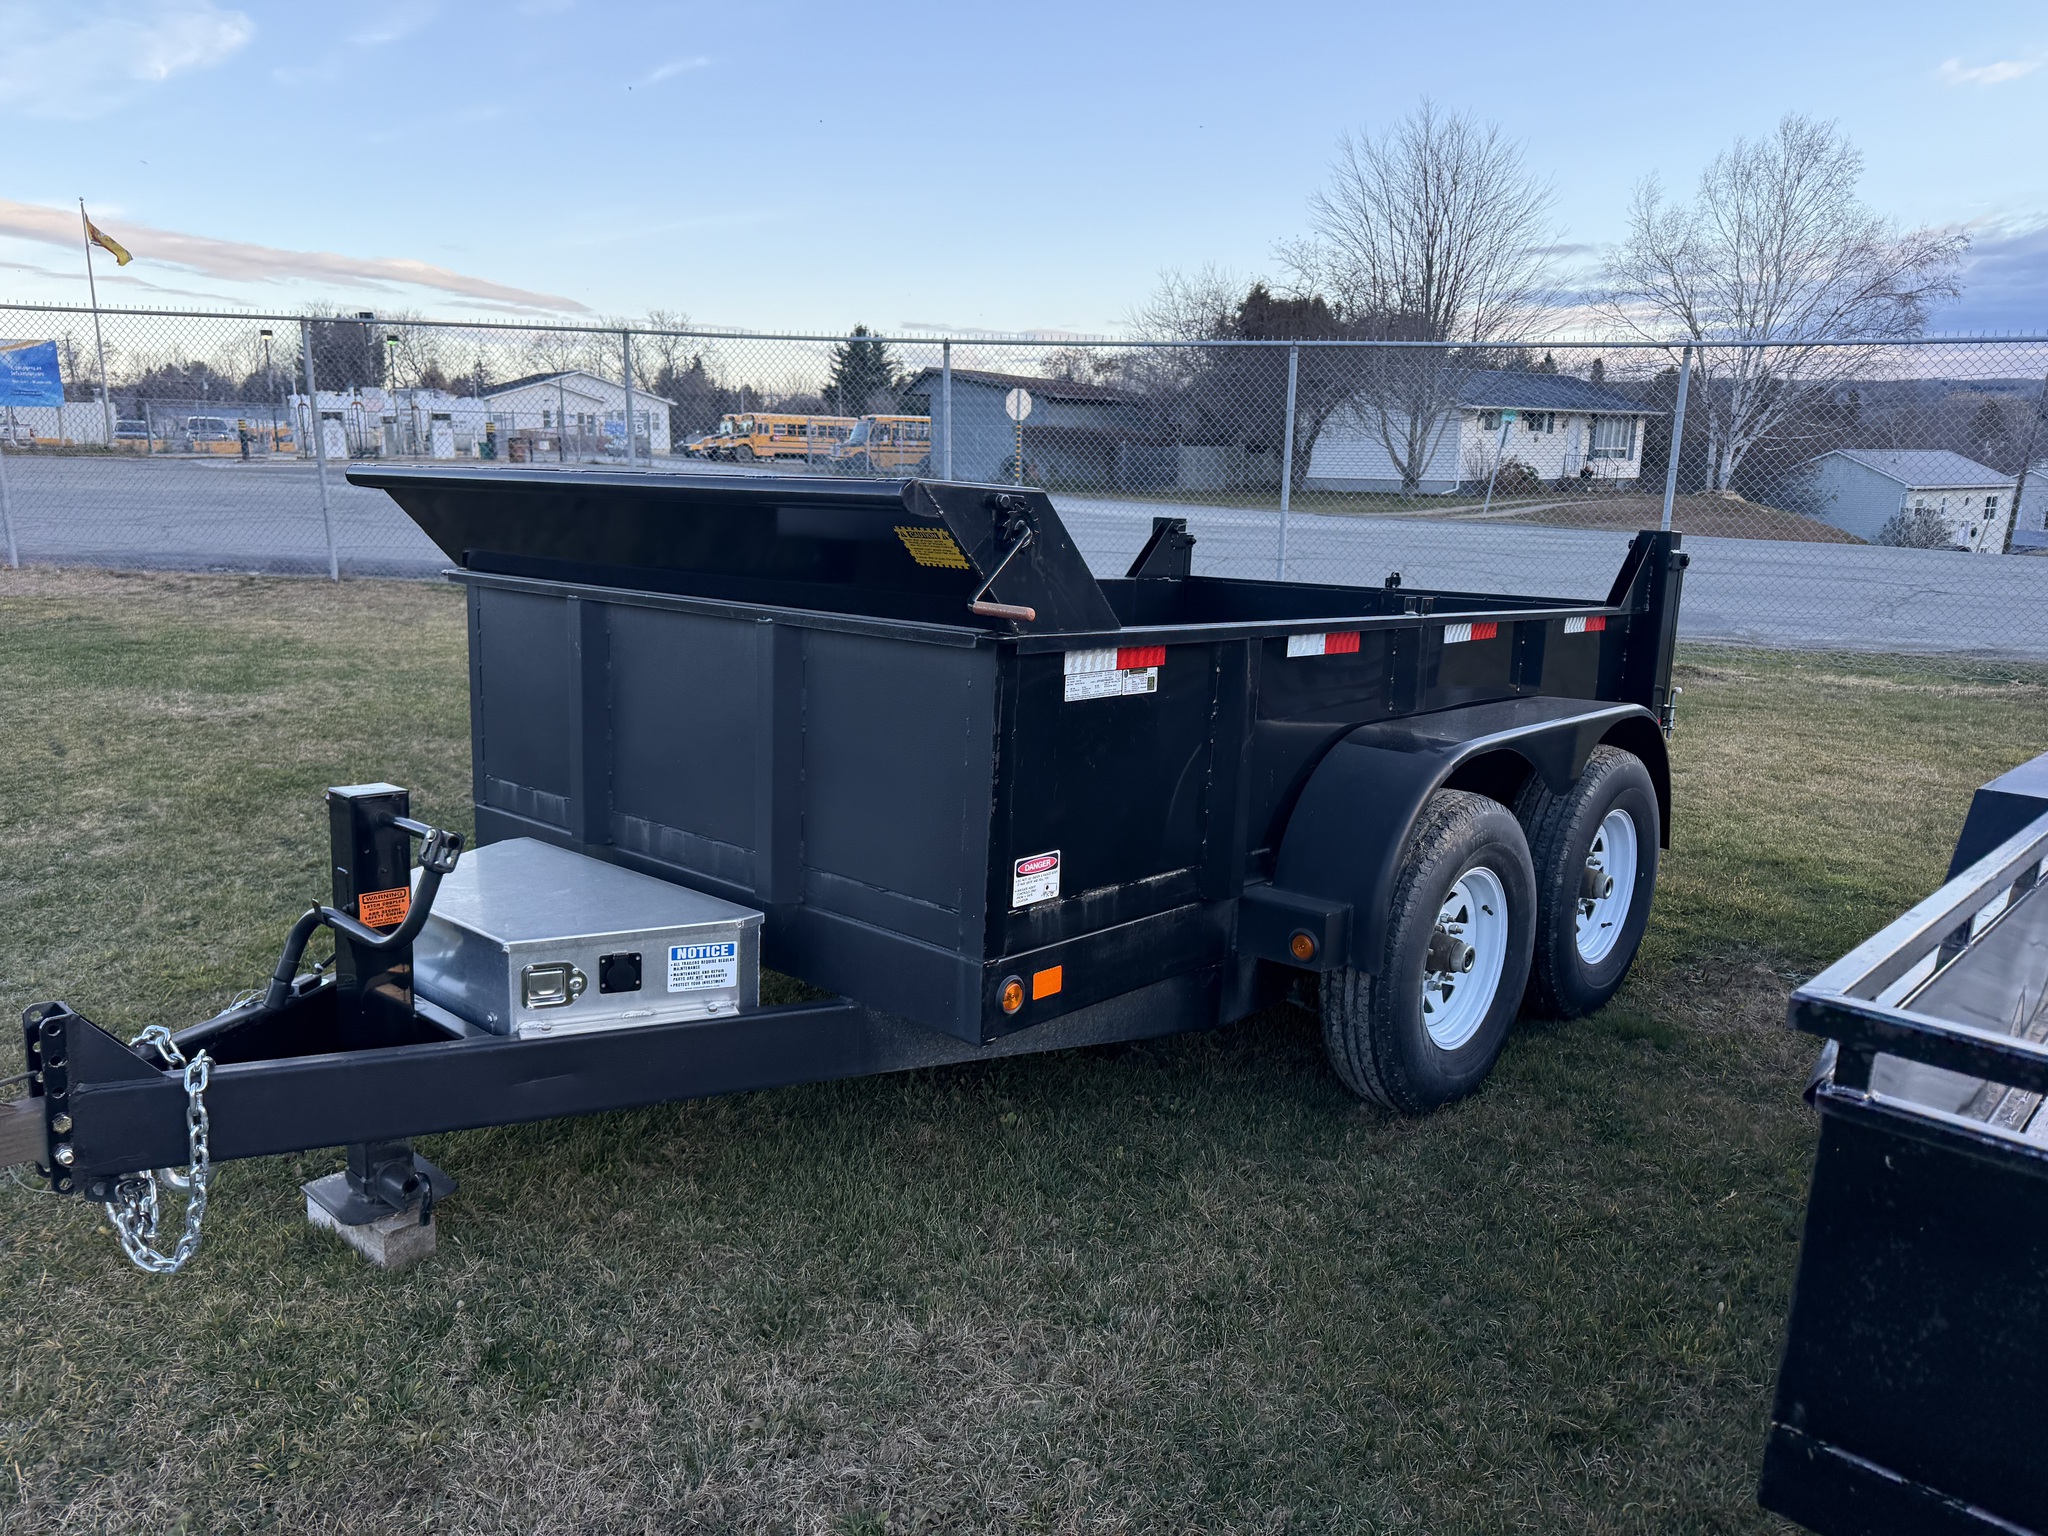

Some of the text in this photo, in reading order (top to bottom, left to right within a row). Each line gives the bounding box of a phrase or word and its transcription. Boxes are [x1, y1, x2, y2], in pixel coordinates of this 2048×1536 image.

[1024, 860, 1051, 872] DANGER
[366, 891, 403, 901] WARNING
[677, 945, 729, 960] NOTICE
